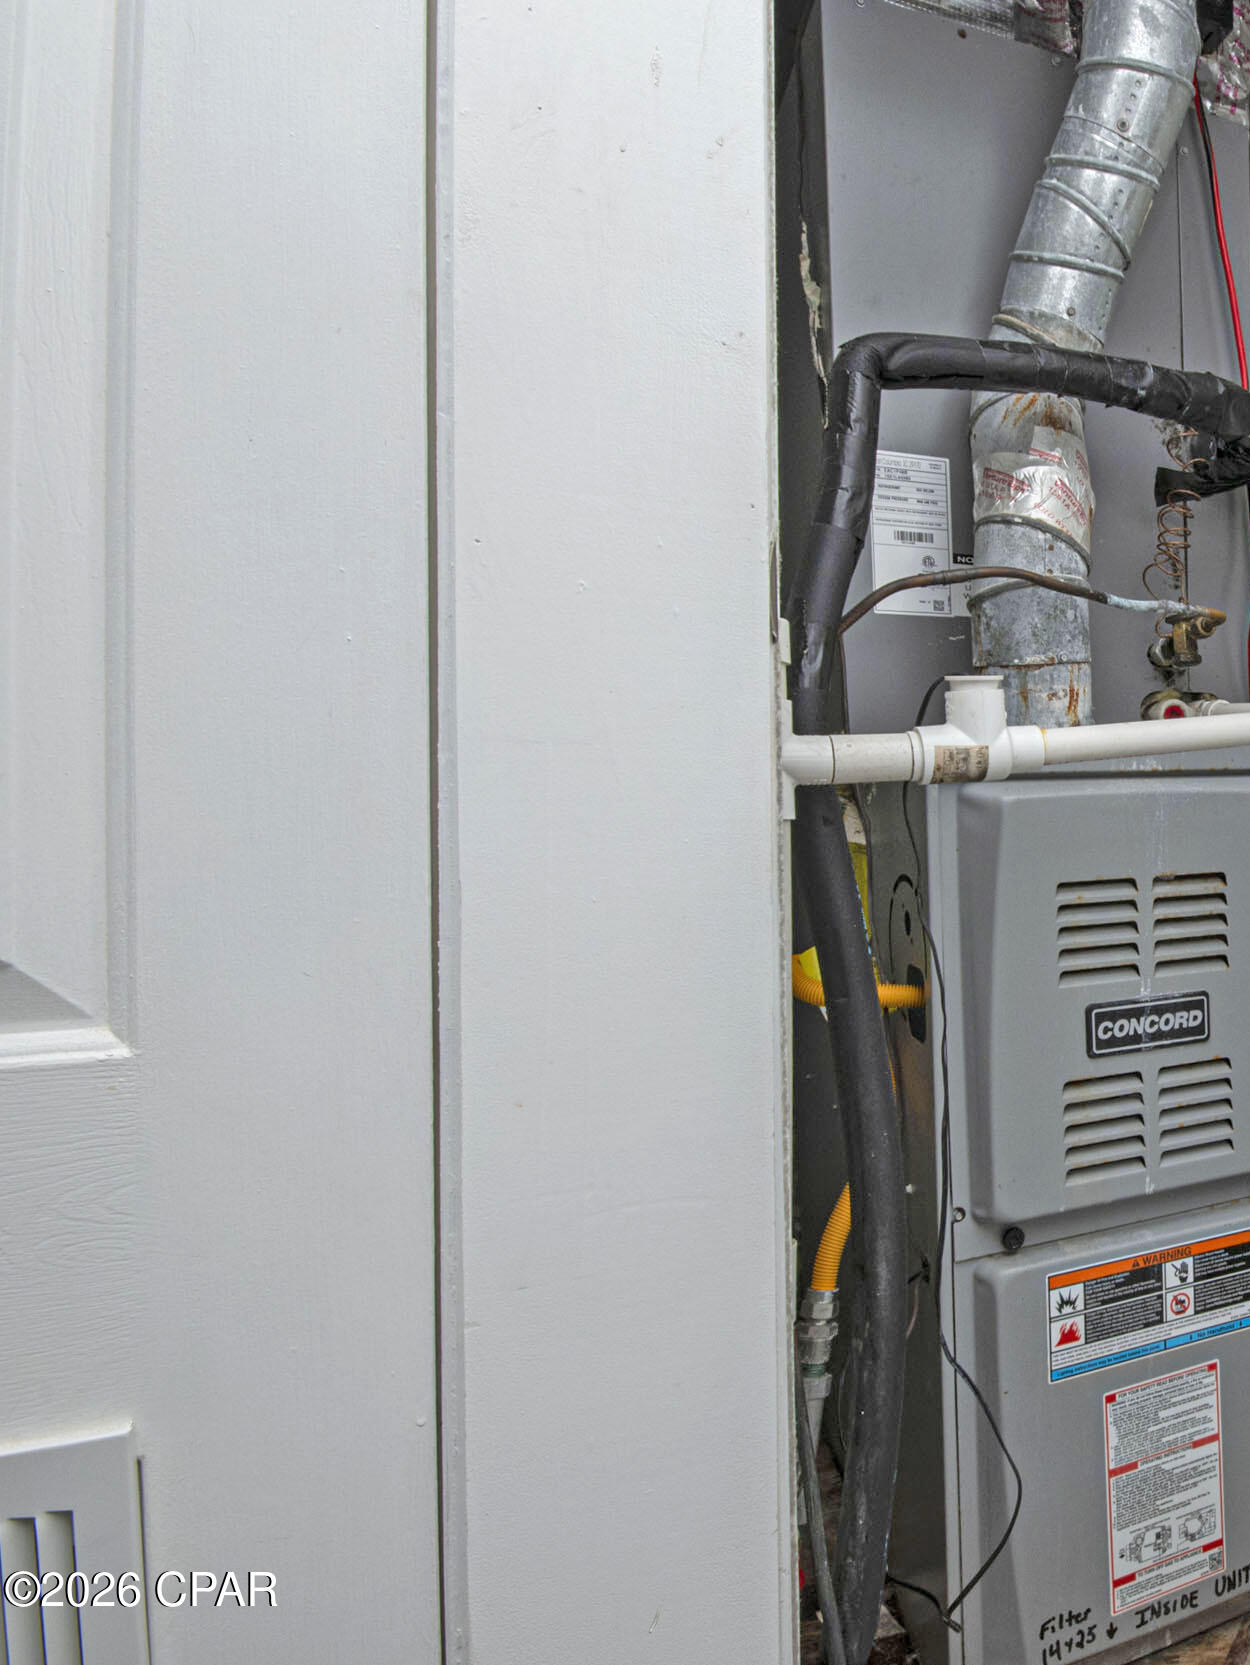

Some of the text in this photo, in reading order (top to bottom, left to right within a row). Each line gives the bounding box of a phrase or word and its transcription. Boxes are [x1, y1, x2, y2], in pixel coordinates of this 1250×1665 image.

[1097, 1009, 1203, 1040] CONCORD
[1142, 1246, 1192, 1266] WARNING
[1039, 1607, 1092, 1640] Filter
[1134, 1590, 1199, 1629] INSIDE
